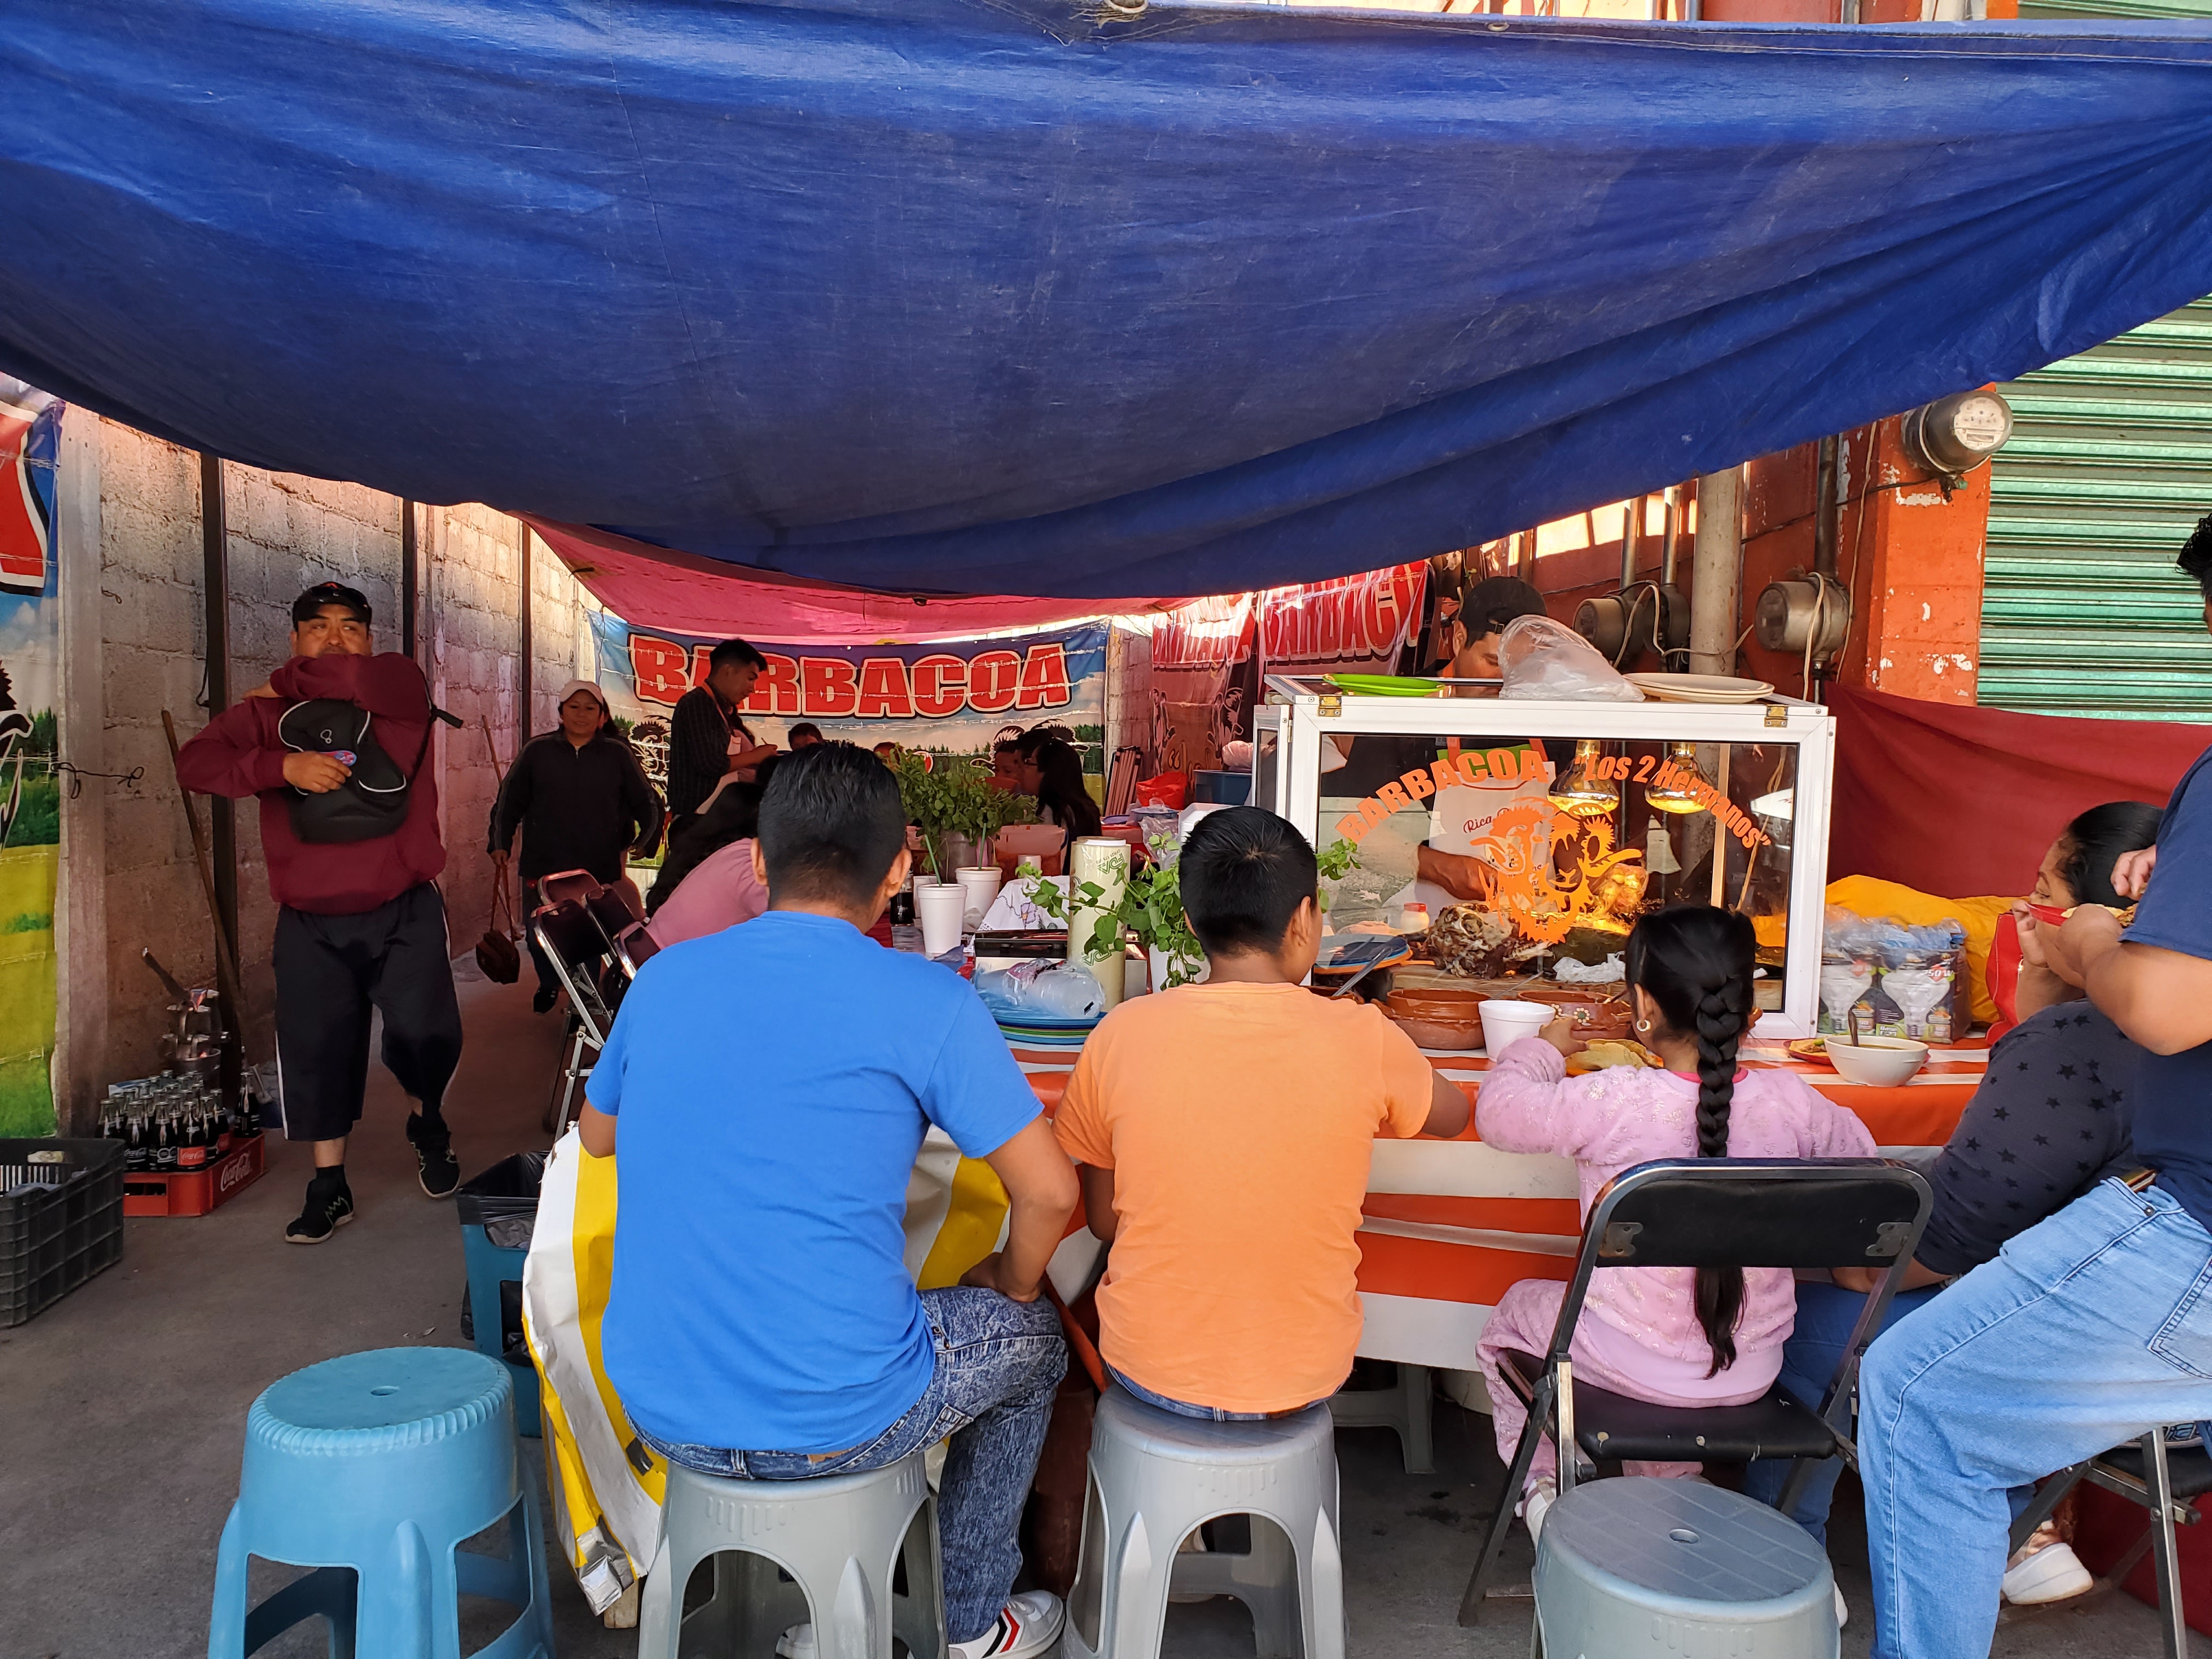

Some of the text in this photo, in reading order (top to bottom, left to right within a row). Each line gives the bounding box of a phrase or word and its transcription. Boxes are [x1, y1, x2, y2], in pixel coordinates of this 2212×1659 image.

[1335, 749, 1549, 843] BARBACOA
[1633, 755, 1656, 783] 2
[1463, 815, 1492, 833] Rica
[1097, 853, 1125, 874] FDA
